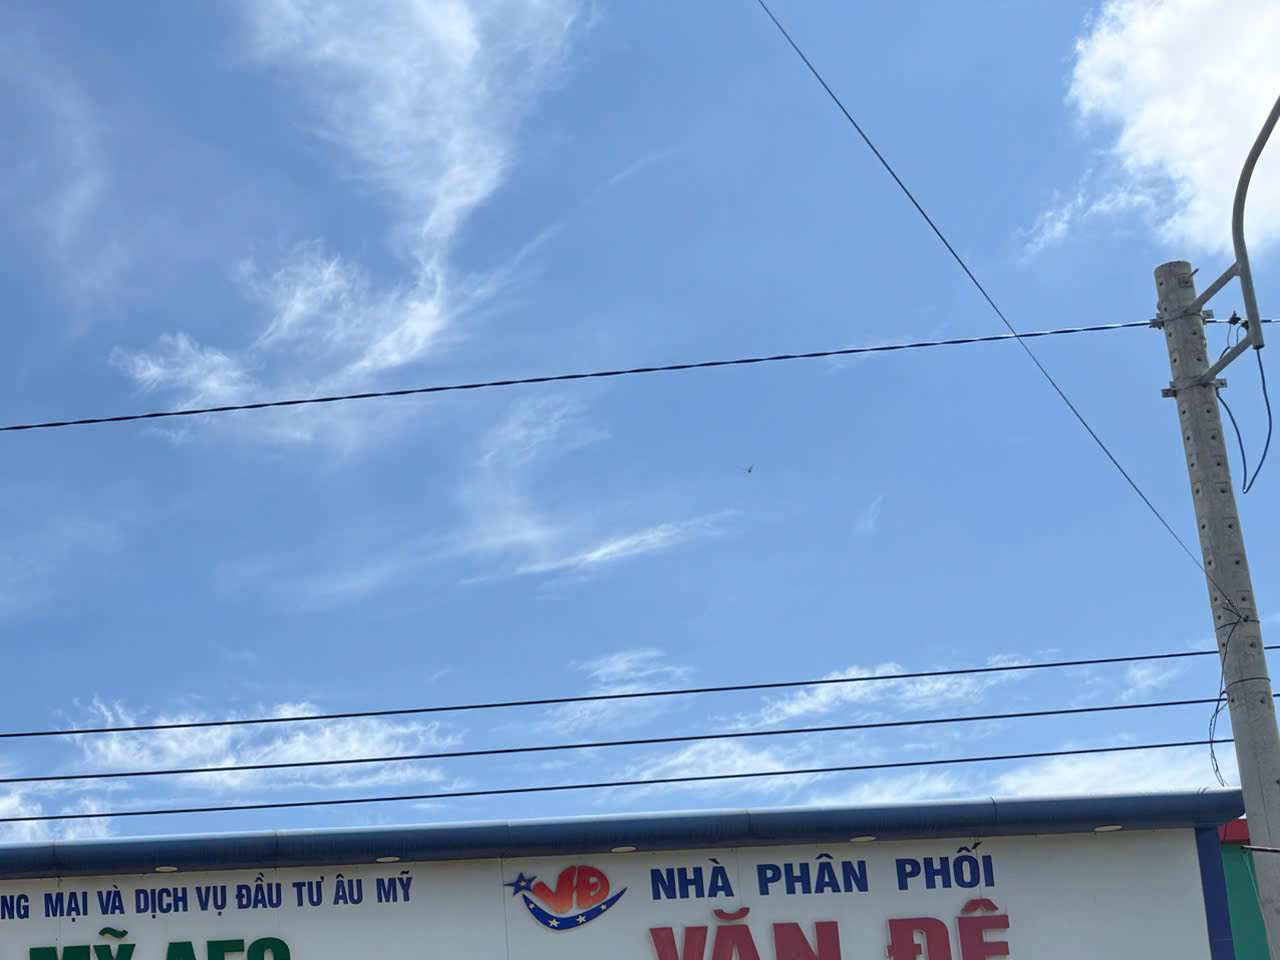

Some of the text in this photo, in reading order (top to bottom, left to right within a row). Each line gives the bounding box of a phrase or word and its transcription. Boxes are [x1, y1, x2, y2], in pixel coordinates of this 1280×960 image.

[44, 891, 88, 922] MẠI
[97, 885, 125, 916] VÀ
[135, 886, 188, 919] DỊCH
[195, 884, 227, 917] VỤ
[235, 872, 282, 909] ĐẦU
[292, 875, 324, 907] TƯ
[333, 873, 363, 905] ÂU
[376, 870, 413, 903] MỸ
[650, 841, 995, 899] NHÀ PHÂN PHỐI
